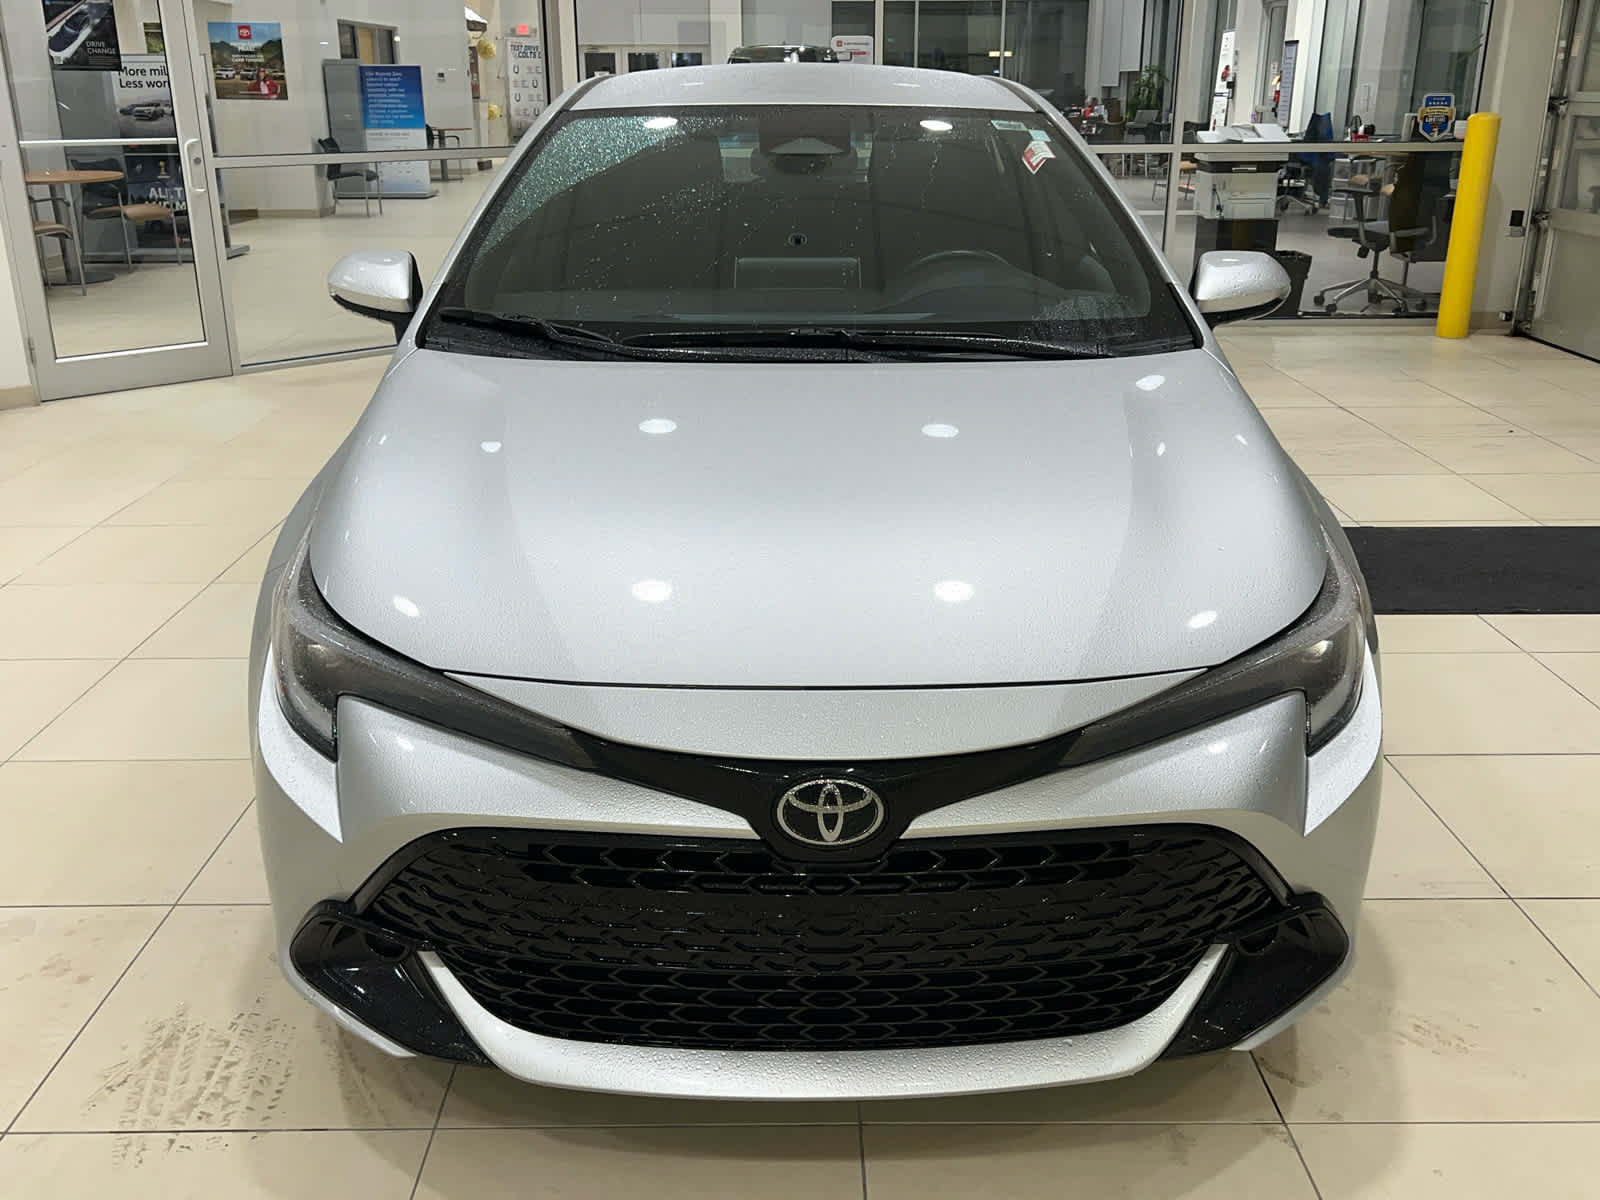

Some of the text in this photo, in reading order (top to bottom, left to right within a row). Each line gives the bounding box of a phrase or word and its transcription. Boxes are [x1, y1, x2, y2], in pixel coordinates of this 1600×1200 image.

[149, 65, 168, 77] mil
[119, 78, 169, 89] Less wor
